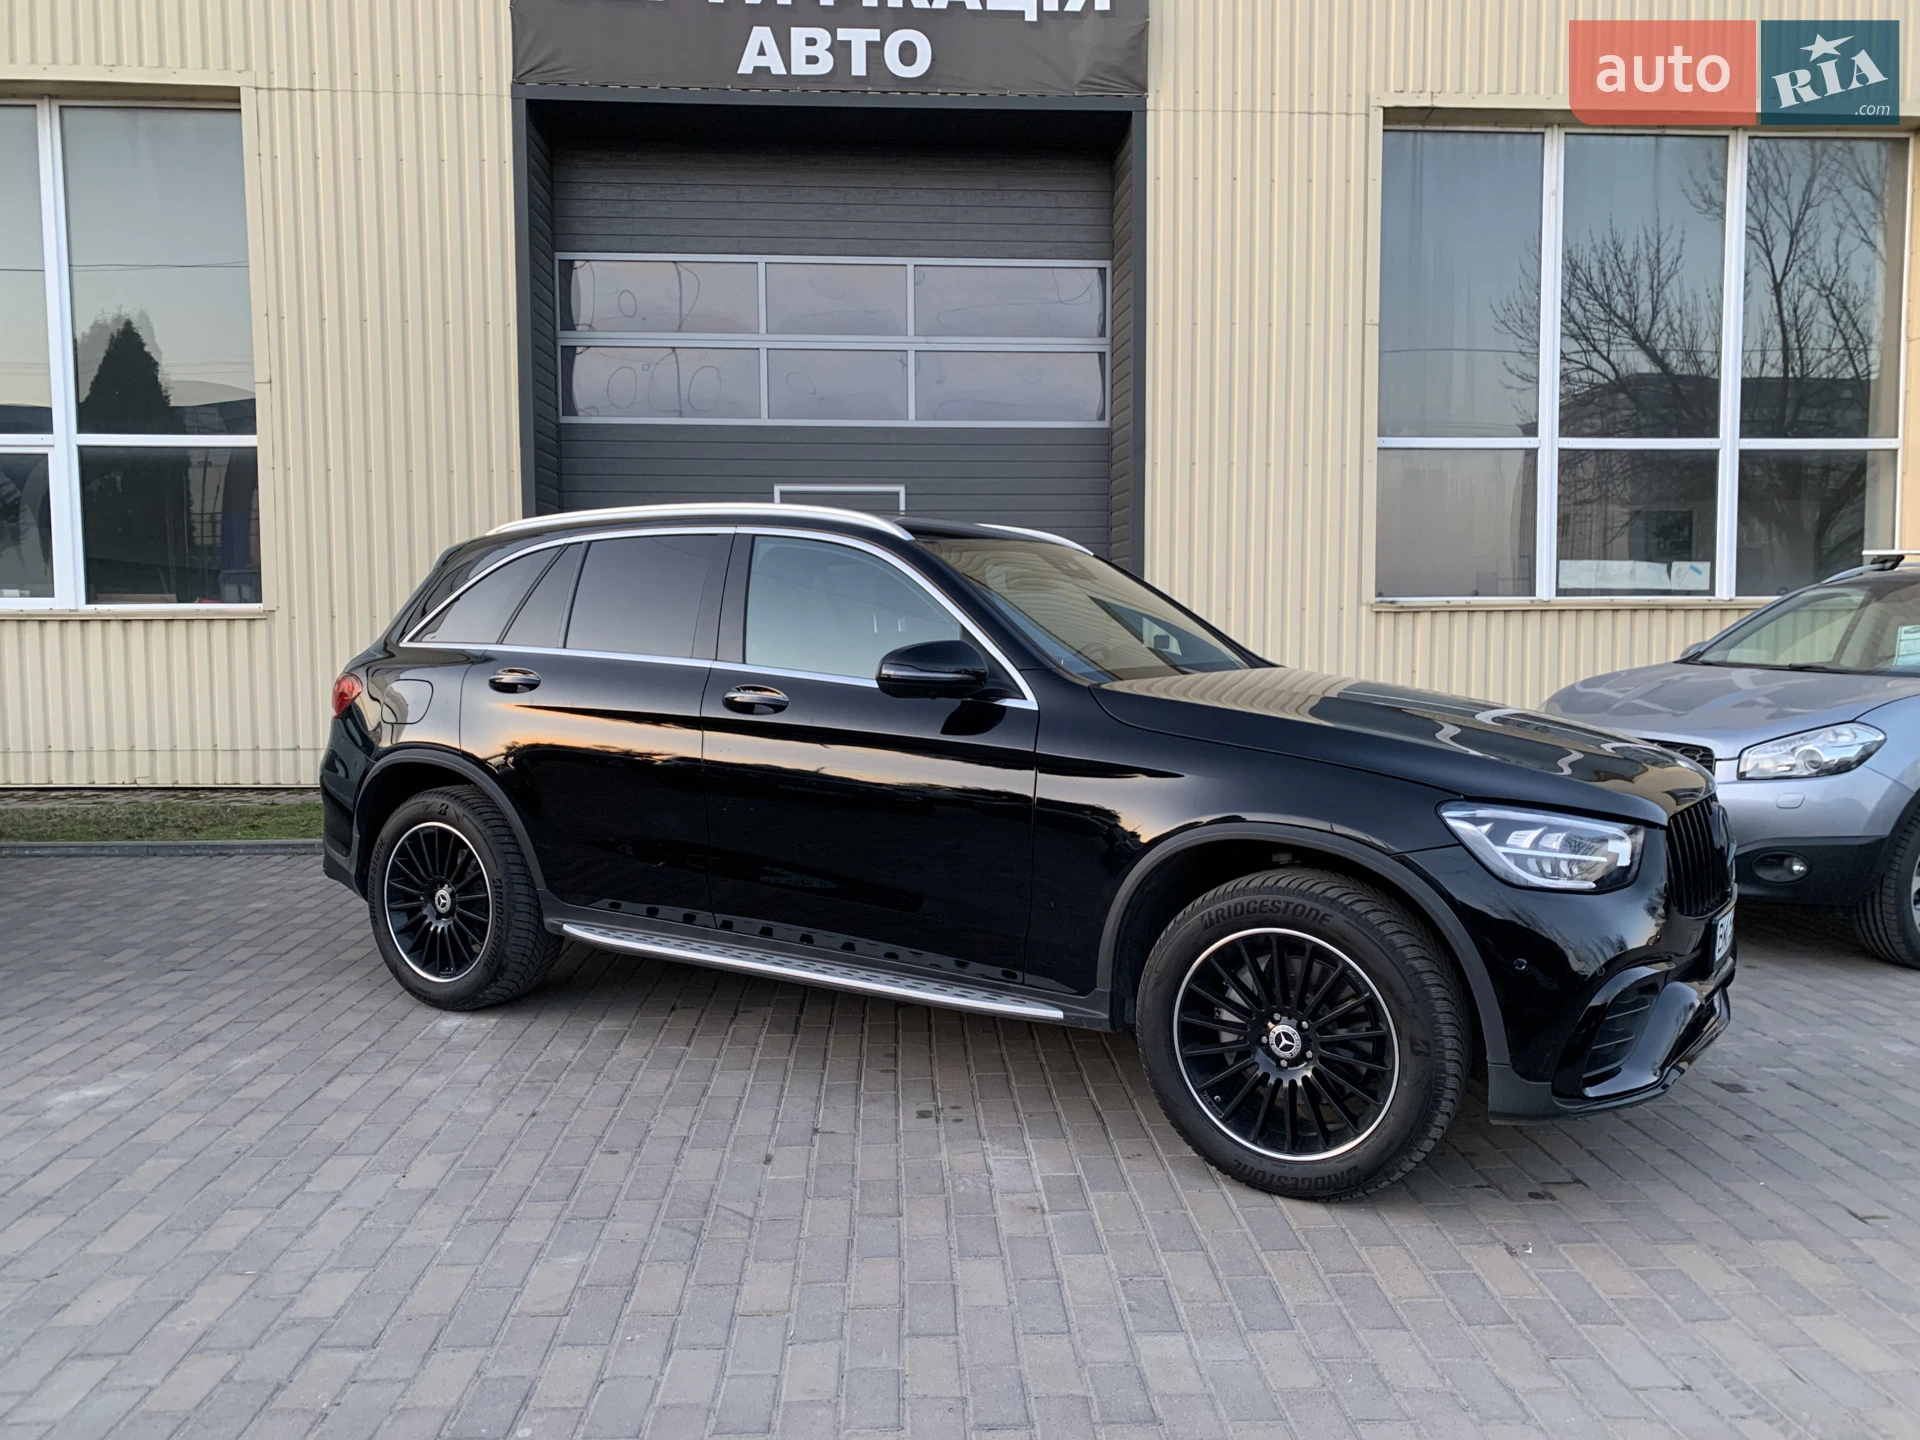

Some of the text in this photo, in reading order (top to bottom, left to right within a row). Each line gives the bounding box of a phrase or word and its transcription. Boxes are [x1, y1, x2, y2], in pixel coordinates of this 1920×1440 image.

[737, 26, 932, 78] АВТО
[484, 878, 504, 973] BRIDGESTONE
[1200, 899, 1334, 932] BRIDGESTONE
